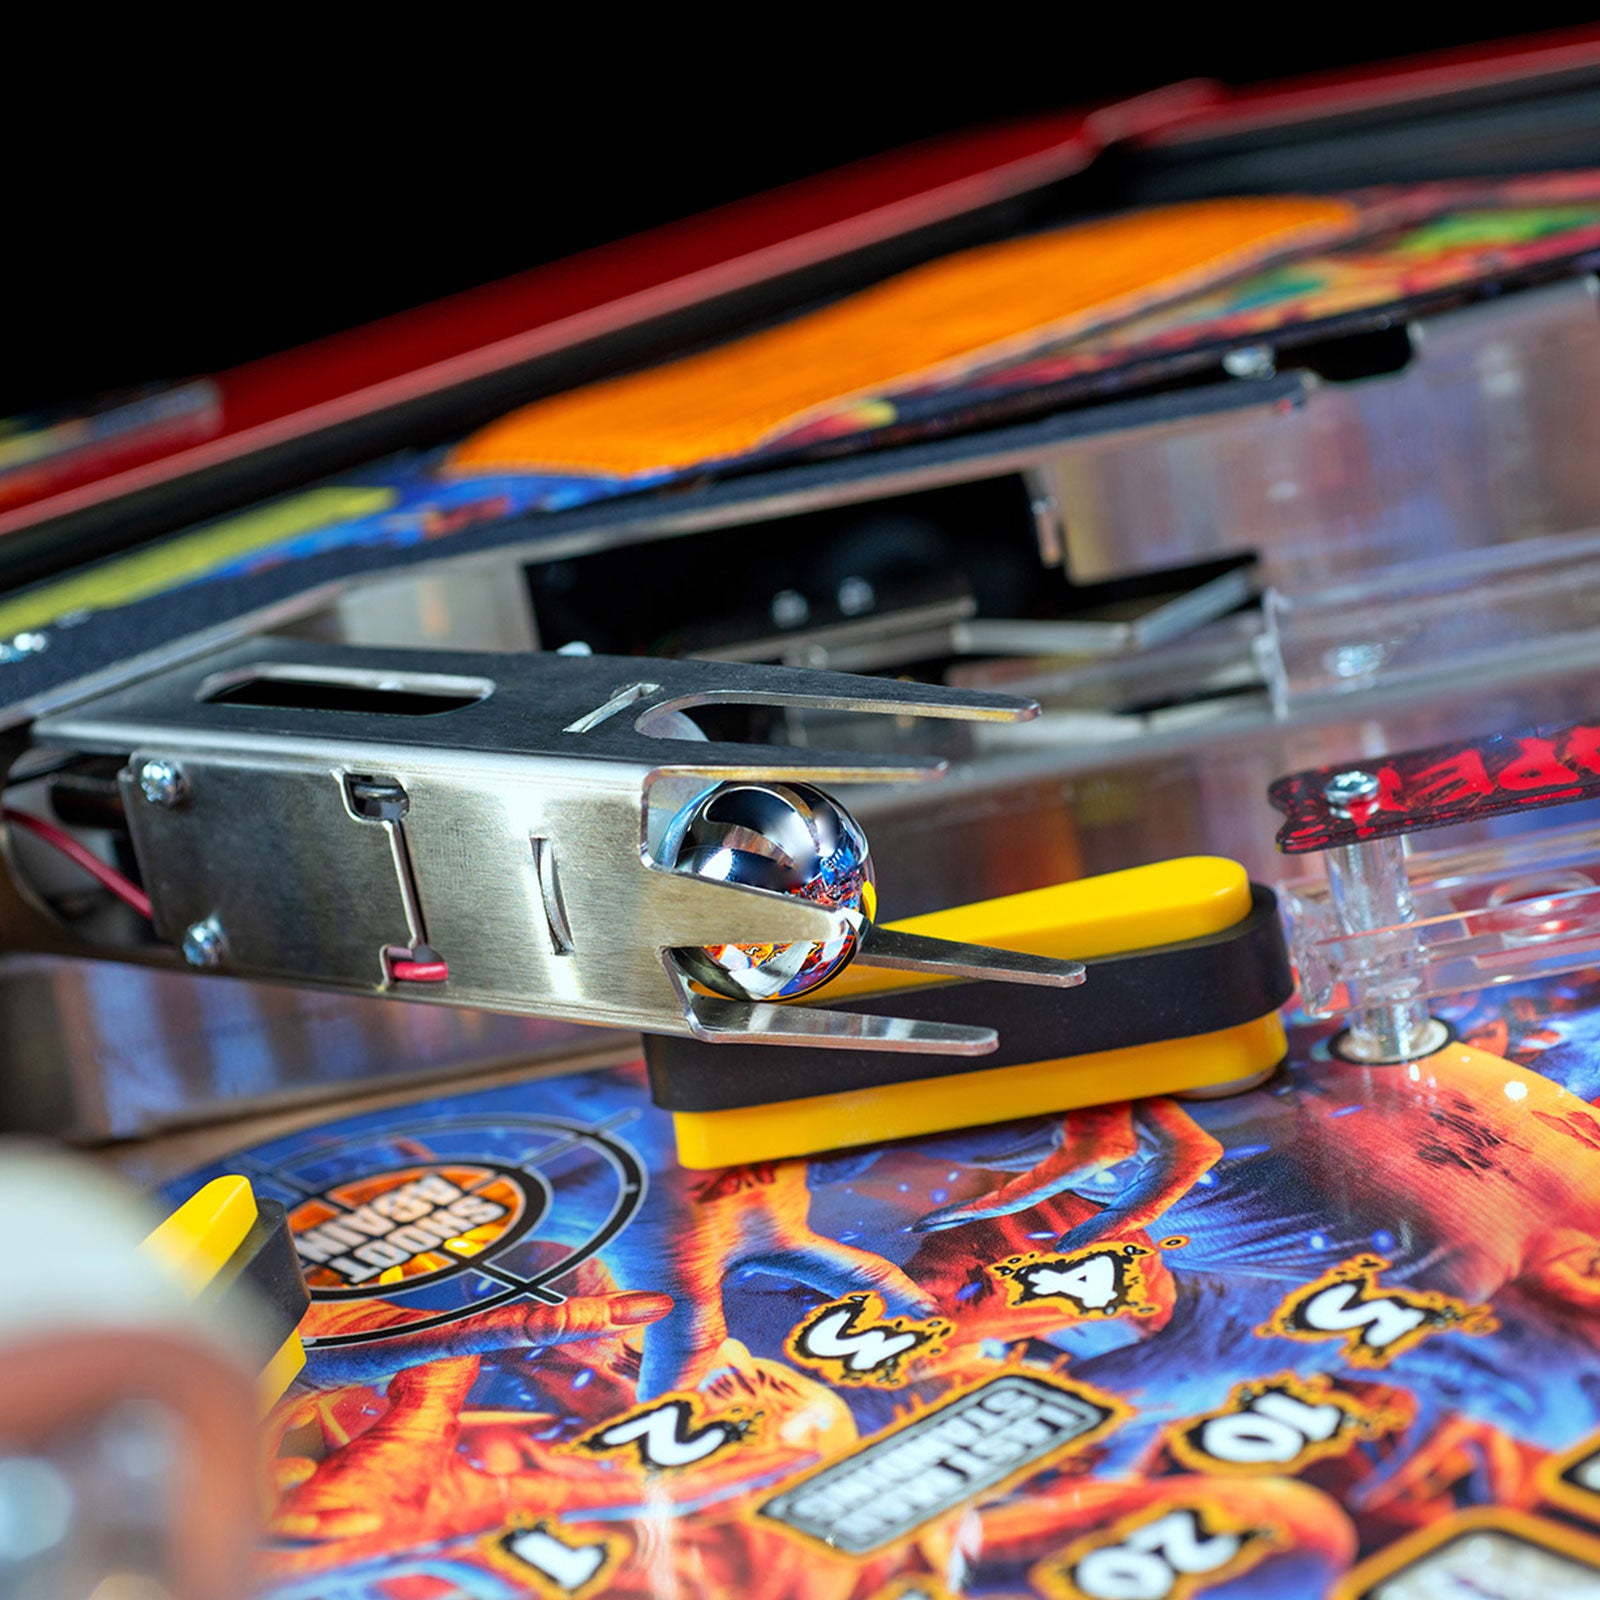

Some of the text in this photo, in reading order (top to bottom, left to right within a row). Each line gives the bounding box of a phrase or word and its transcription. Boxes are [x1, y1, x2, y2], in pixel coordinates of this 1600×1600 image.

[294, 1174, 463, 1263] AGAIN
[327, 1195, 506, 1284] SHOOT
[1028, 1256, 1116, 1308] 4
[1306, 1283, 1425, 1347] 5
[806, 1309, 916, 1371] 3
[602, 1405, 726, 1467] 2
[944, 1401, 1085, 1477] LAST
[1201, 1392, 1342, 1463] 10
[511, 1531, 605, 1590] 1
[1075, 1510, 1240, 1600] 20
